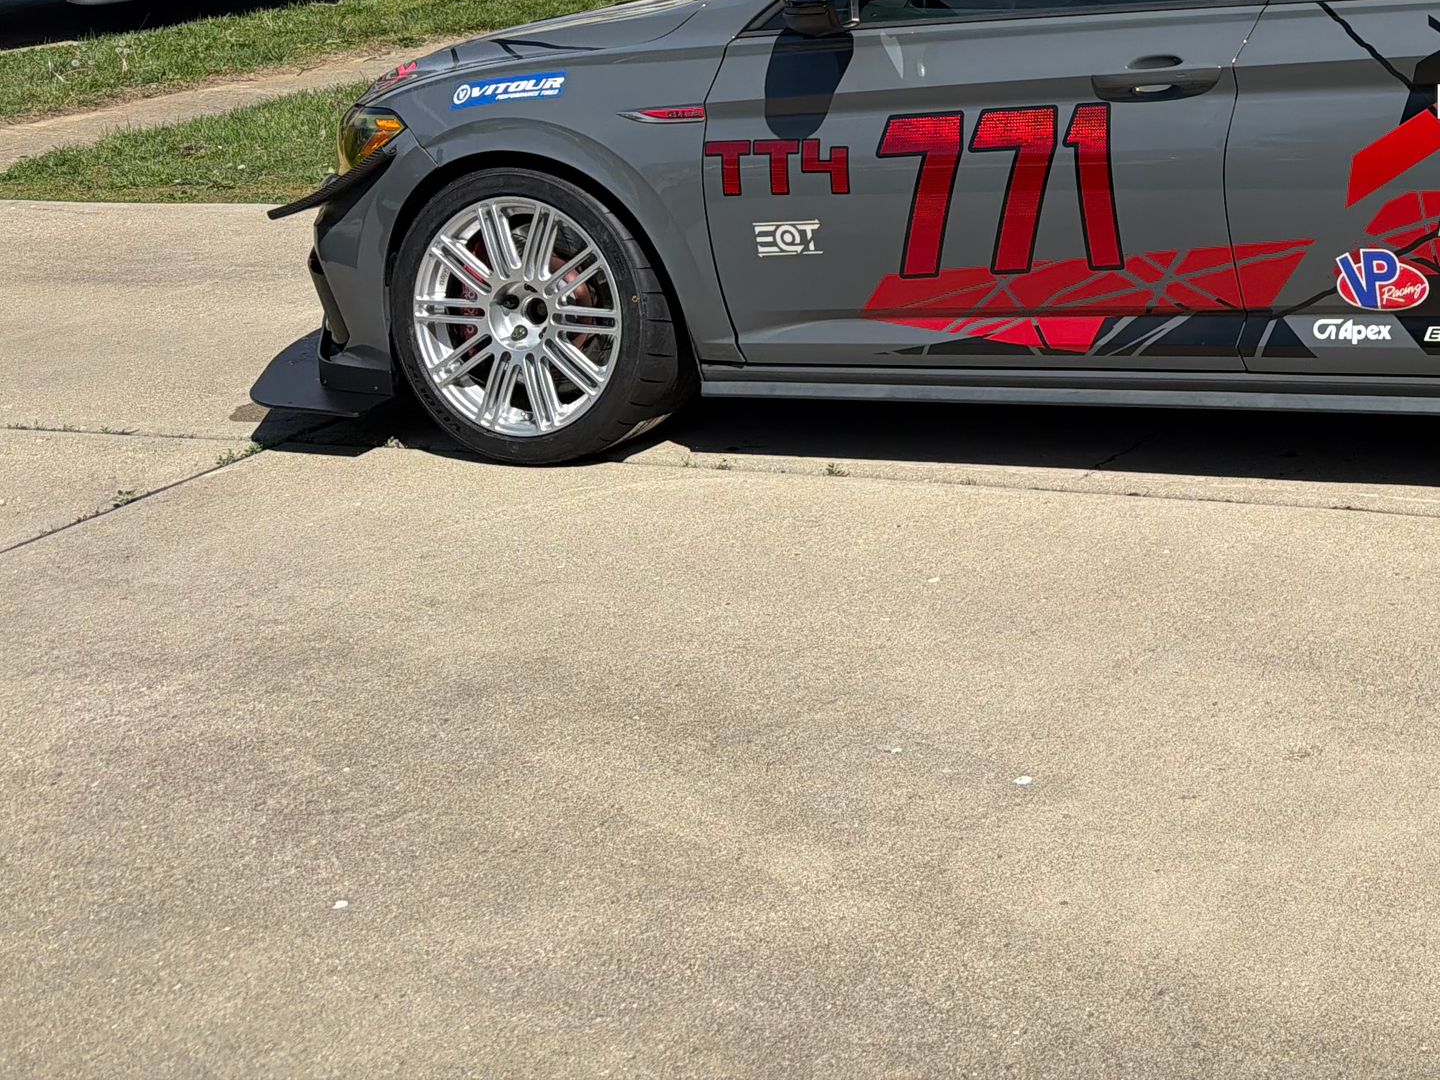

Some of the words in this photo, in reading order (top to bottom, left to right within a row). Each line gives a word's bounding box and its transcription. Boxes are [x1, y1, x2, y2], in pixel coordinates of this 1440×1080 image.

[471, 77, 565, 97] VITOUR
[704, 138, 850, 196] TT4
[876, 102, 1125, 279] 771
[752, 219, 824, 258] EQT
[1336, 248, 1399, 310] VP
[1381, 282, 1426, 305] Racing
